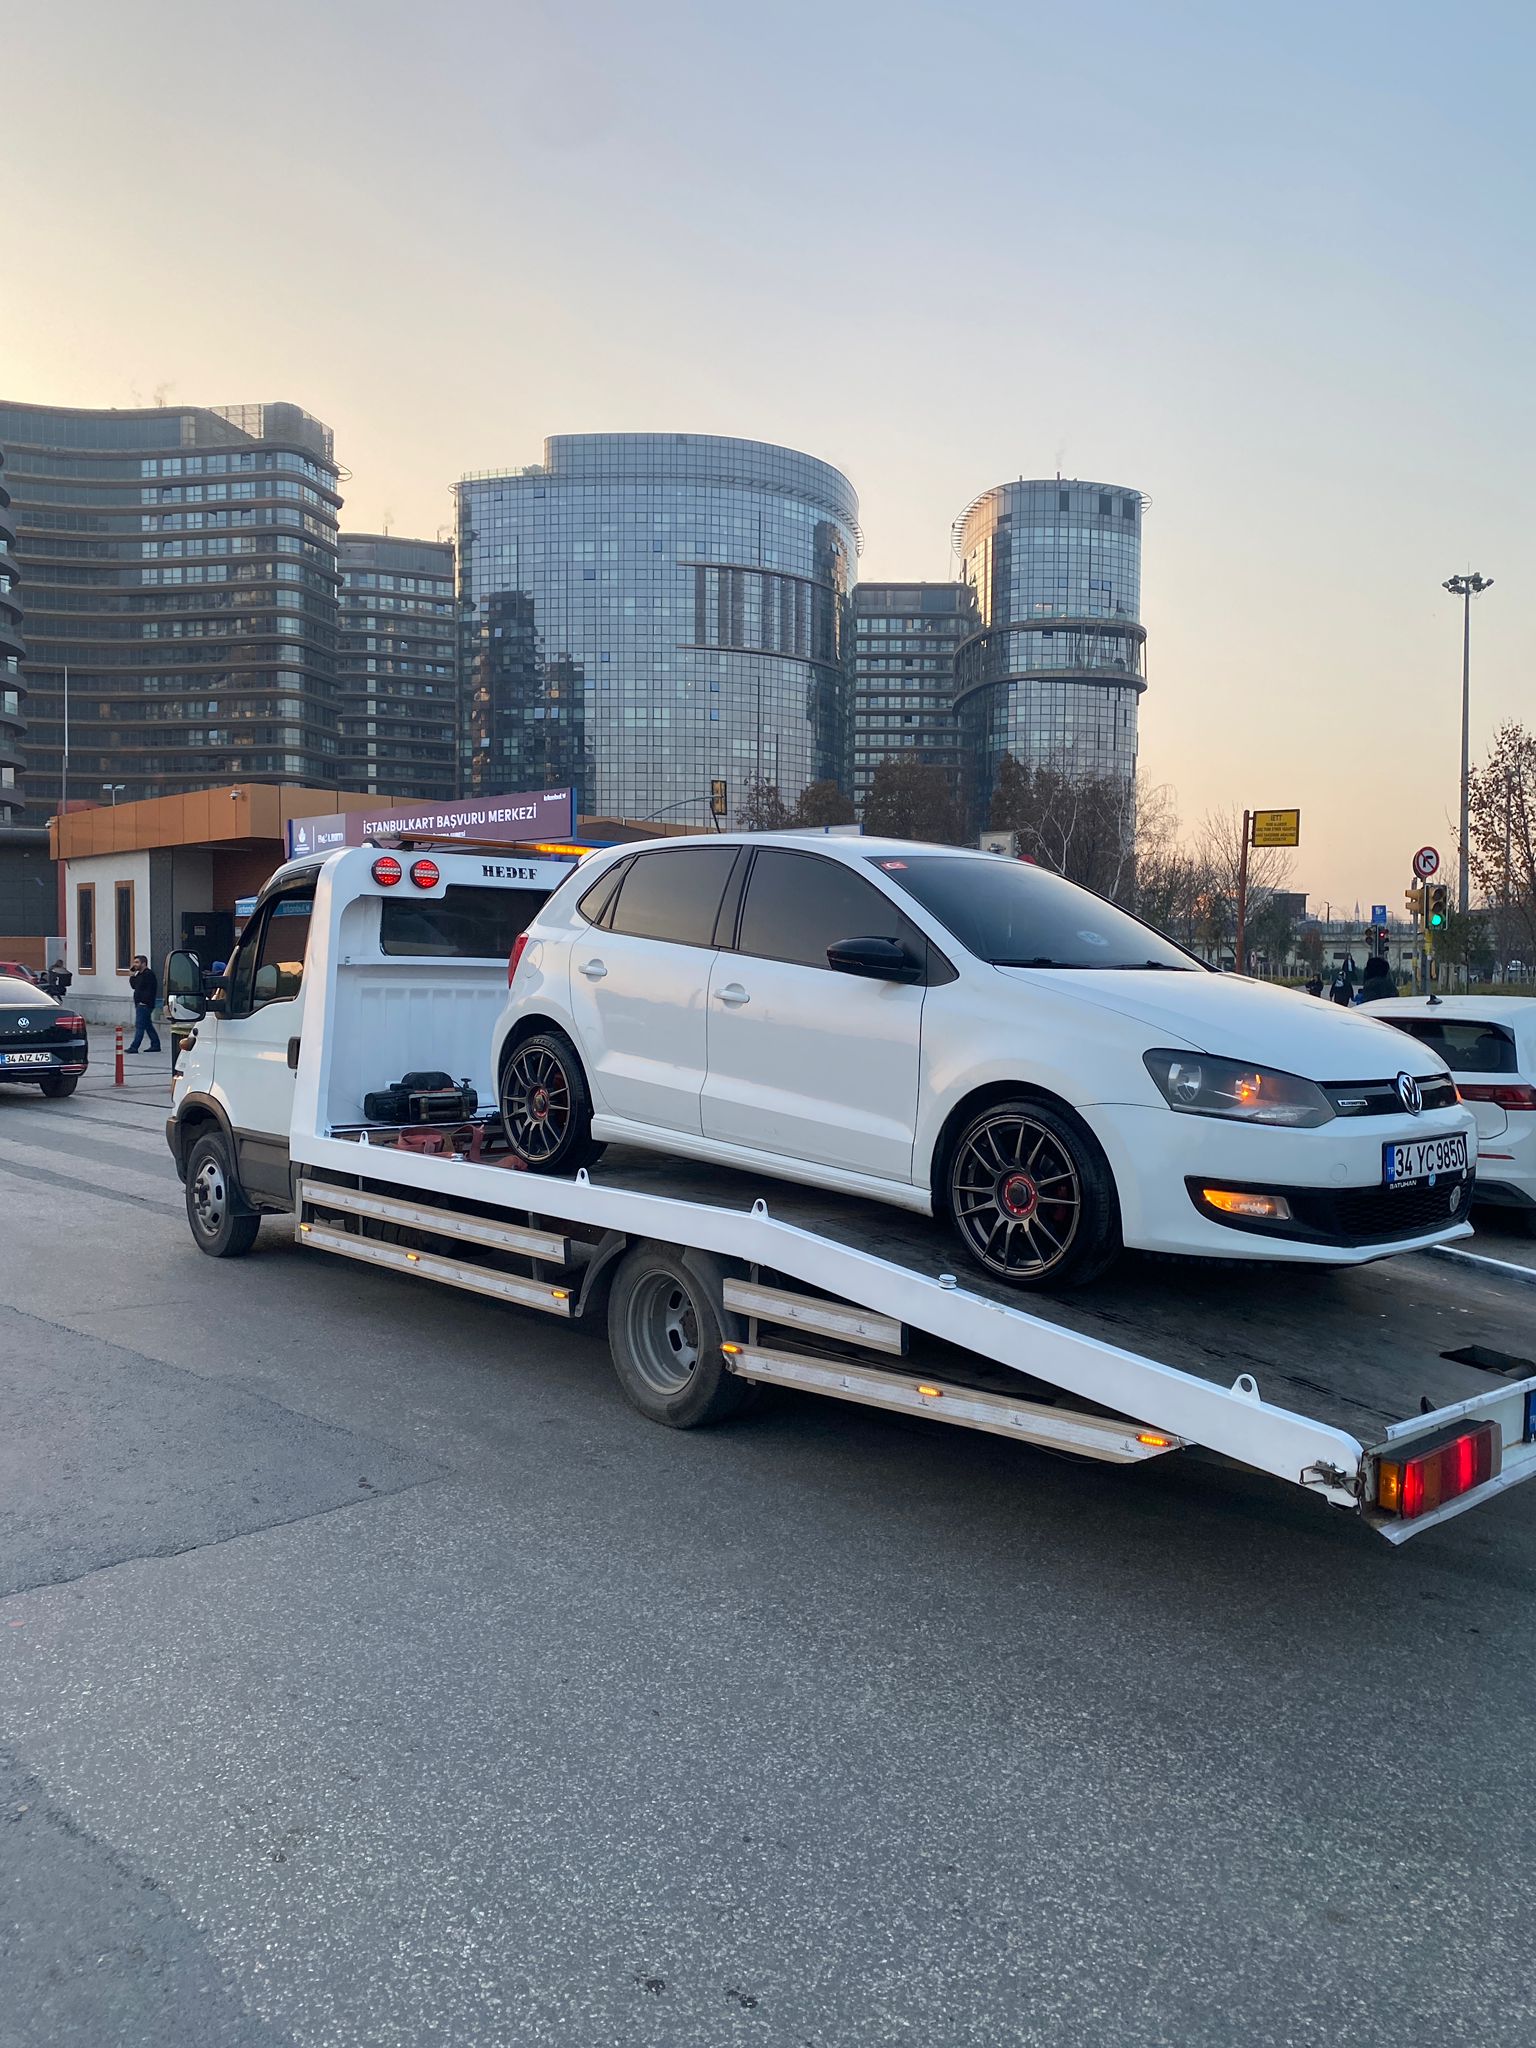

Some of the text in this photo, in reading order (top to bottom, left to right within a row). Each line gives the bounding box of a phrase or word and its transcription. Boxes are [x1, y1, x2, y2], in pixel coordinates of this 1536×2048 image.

[363, 817, 434, 834] İSTANBULKART
[437, 811, 486, 828] BAŞVURU
[489, 803, 537, 822] MERKEZİ
[482, 865, 537, 880] HEDEF
[6, 1055, 16, 1063] 34
[35, 1053, 50, 1061] 475
[1396, 1146, 1413, 1177] 34
[1417, 1144, 1434, 1174] YC
[1436, 1139, 1465, 1170] 9850
[1390, 1179, 1417, 1189] BATUHAN
